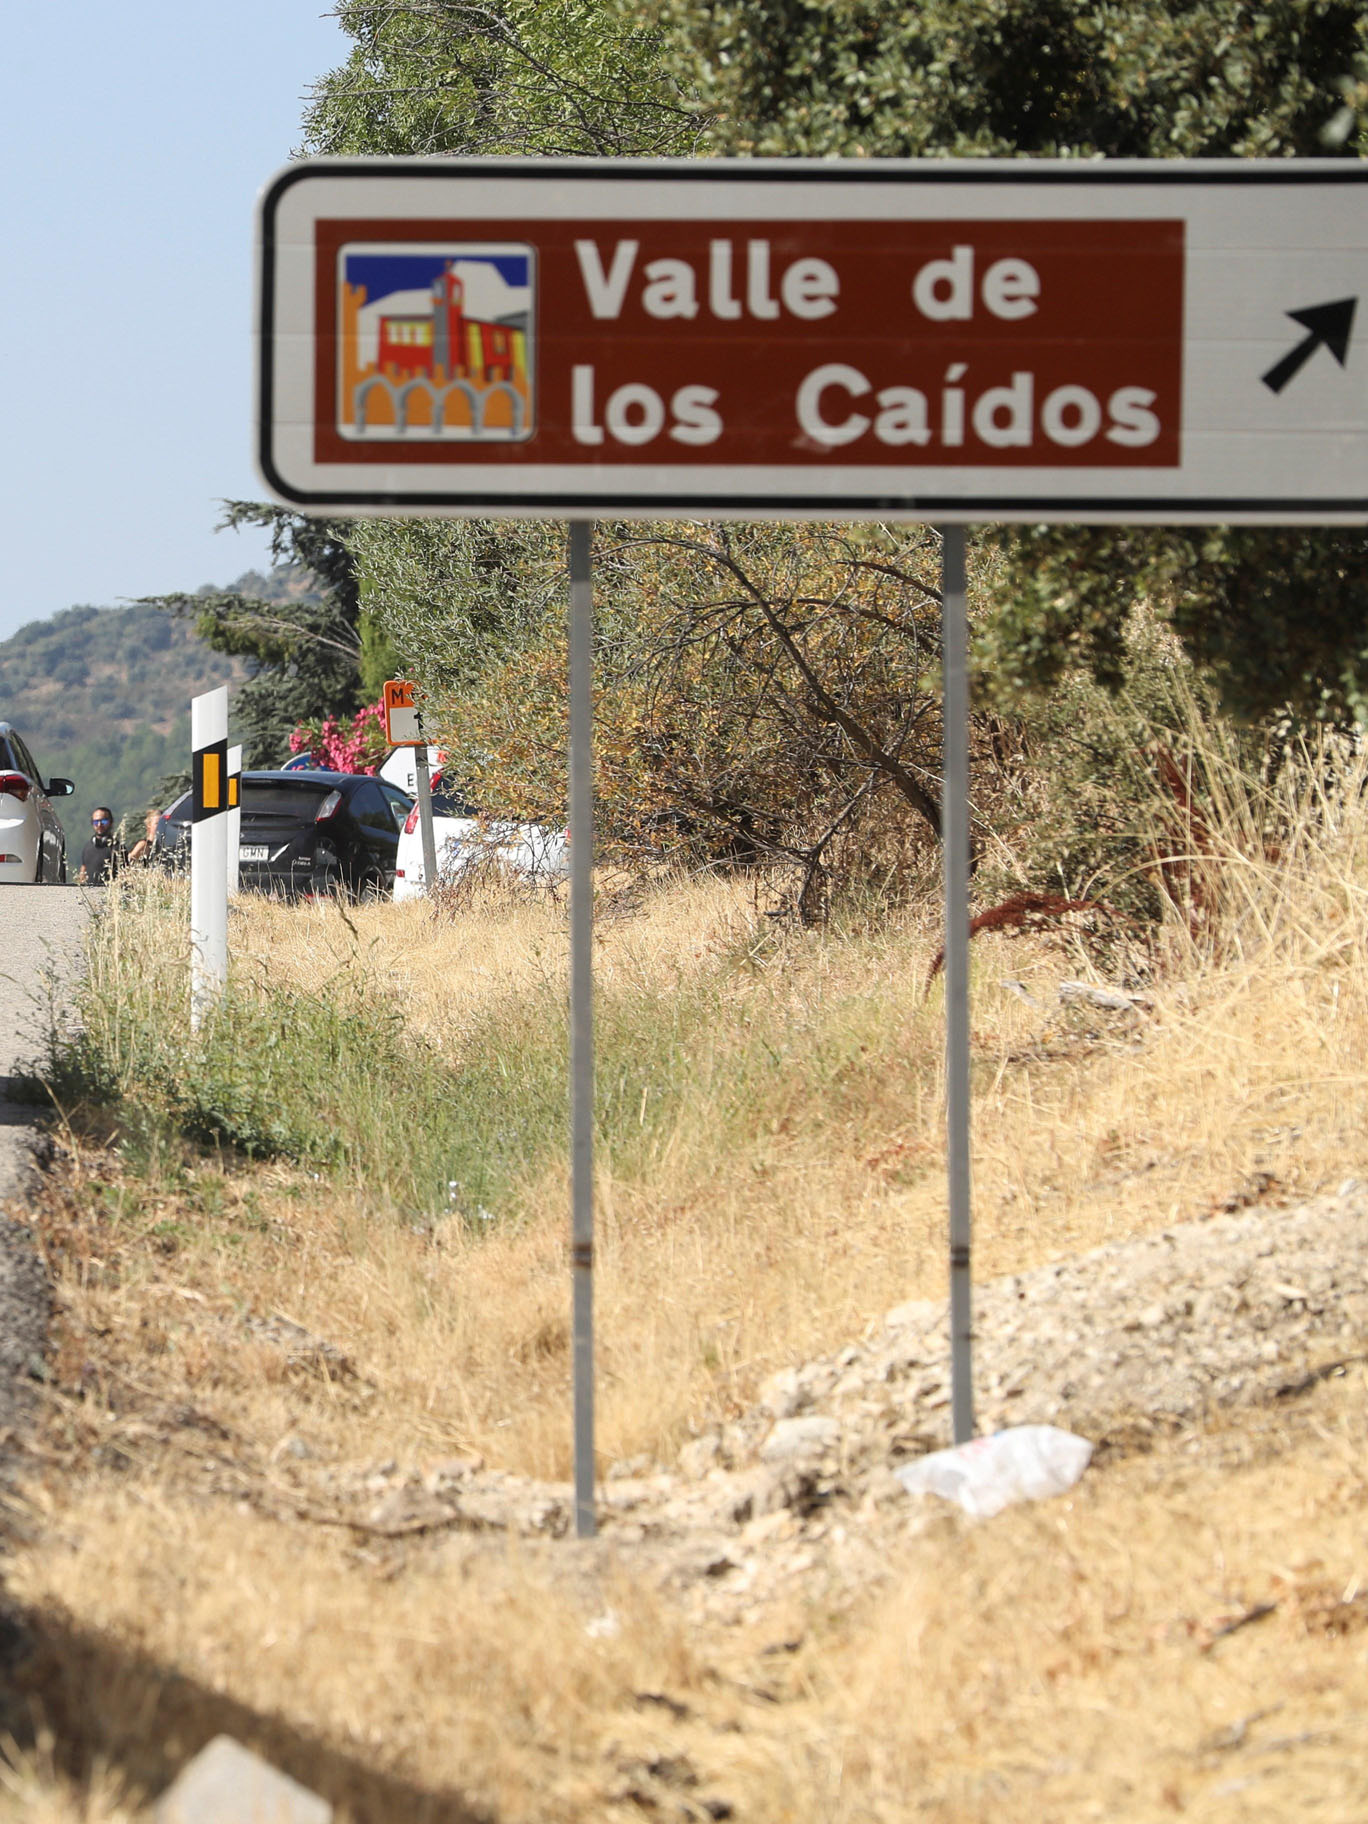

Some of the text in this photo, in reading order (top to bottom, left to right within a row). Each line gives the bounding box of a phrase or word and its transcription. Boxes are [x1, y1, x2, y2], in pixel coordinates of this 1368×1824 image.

[575, 240, 1040, 320] Valle de
[572, 363, 1161, 447] los Caídos
